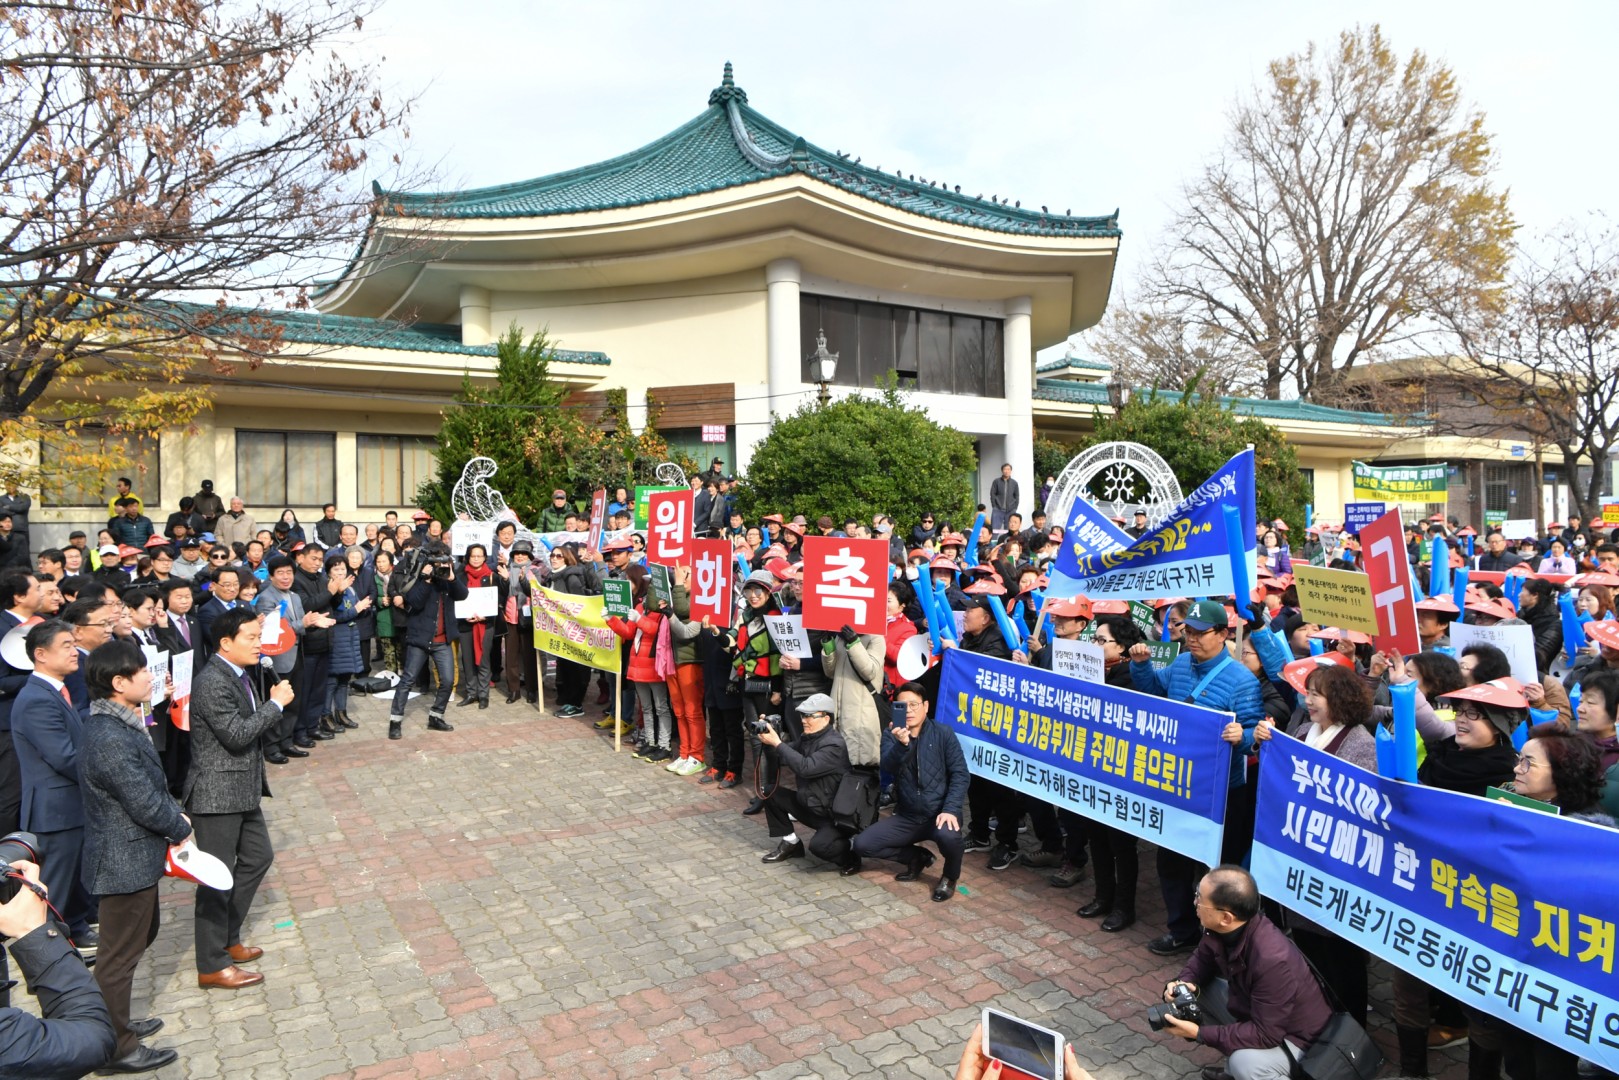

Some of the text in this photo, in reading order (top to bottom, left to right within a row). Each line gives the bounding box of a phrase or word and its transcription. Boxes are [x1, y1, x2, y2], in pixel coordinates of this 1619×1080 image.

[591, 498, 602, 547] 공
[654, 500, 685, 559] 원
[695, 550, 727, 615] 화
[815, 546, 875, 625] 촉
[1084, 563, 1215, 593] 새마을문고해운대구지부
[1308, 590, 1320, 600] 즉각
[1323, 593, 1348, 603] 중지하라
[1341, 584, 1366, 595] 상업화를
[1370, 535, 1406, 637] 구
[1132, 605, 1148, 619] 빌딩
[1190, 603, 1201, 618] A
[1058, 661, 1079, 671] 부자들의
[1158, 646, 1164, 658] 숲
[1165, 646, 1171, 659] 속
[975, 667, 1178, 745] 국토교통부, 한국철도시설공단에 보내는 메시지!!
[957, 691, 1193, 800] 옛 해운대역 정거장부지를 주민의 품으로!!
[971, 743, 1164, 834] 새마을지도자해운대구협의회
[1281, 801, 1617, 974] 시민에게 한 약속을 지켜
